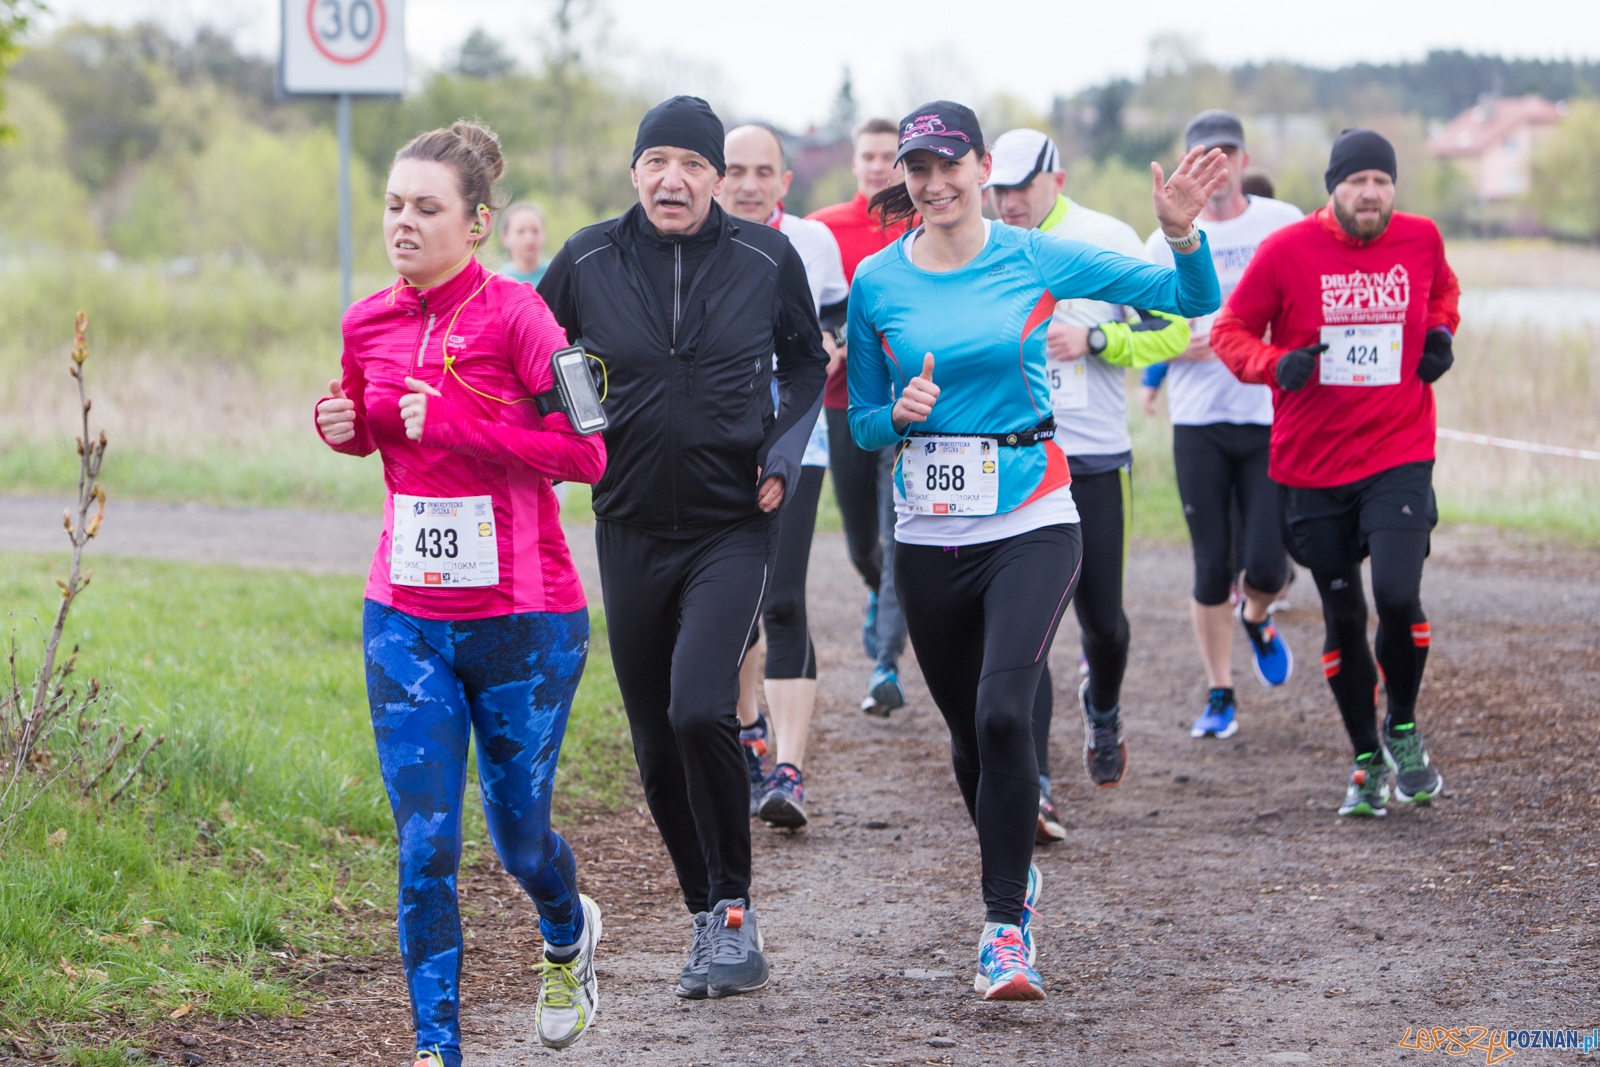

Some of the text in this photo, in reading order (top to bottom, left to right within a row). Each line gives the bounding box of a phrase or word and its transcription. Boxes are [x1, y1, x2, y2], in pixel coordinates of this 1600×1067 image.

[320, 0, 374, 42] 30
[1320, 269, 1396, 290] DRUŻYNA
[1321, 284, 1410, 312] SZPIKU
[1346, 345, 1378, 365] 424
[926, 464, 965, 491] 858
[415, 528, 458, 558] 433
[453, 562, 477, 570] 10KM
